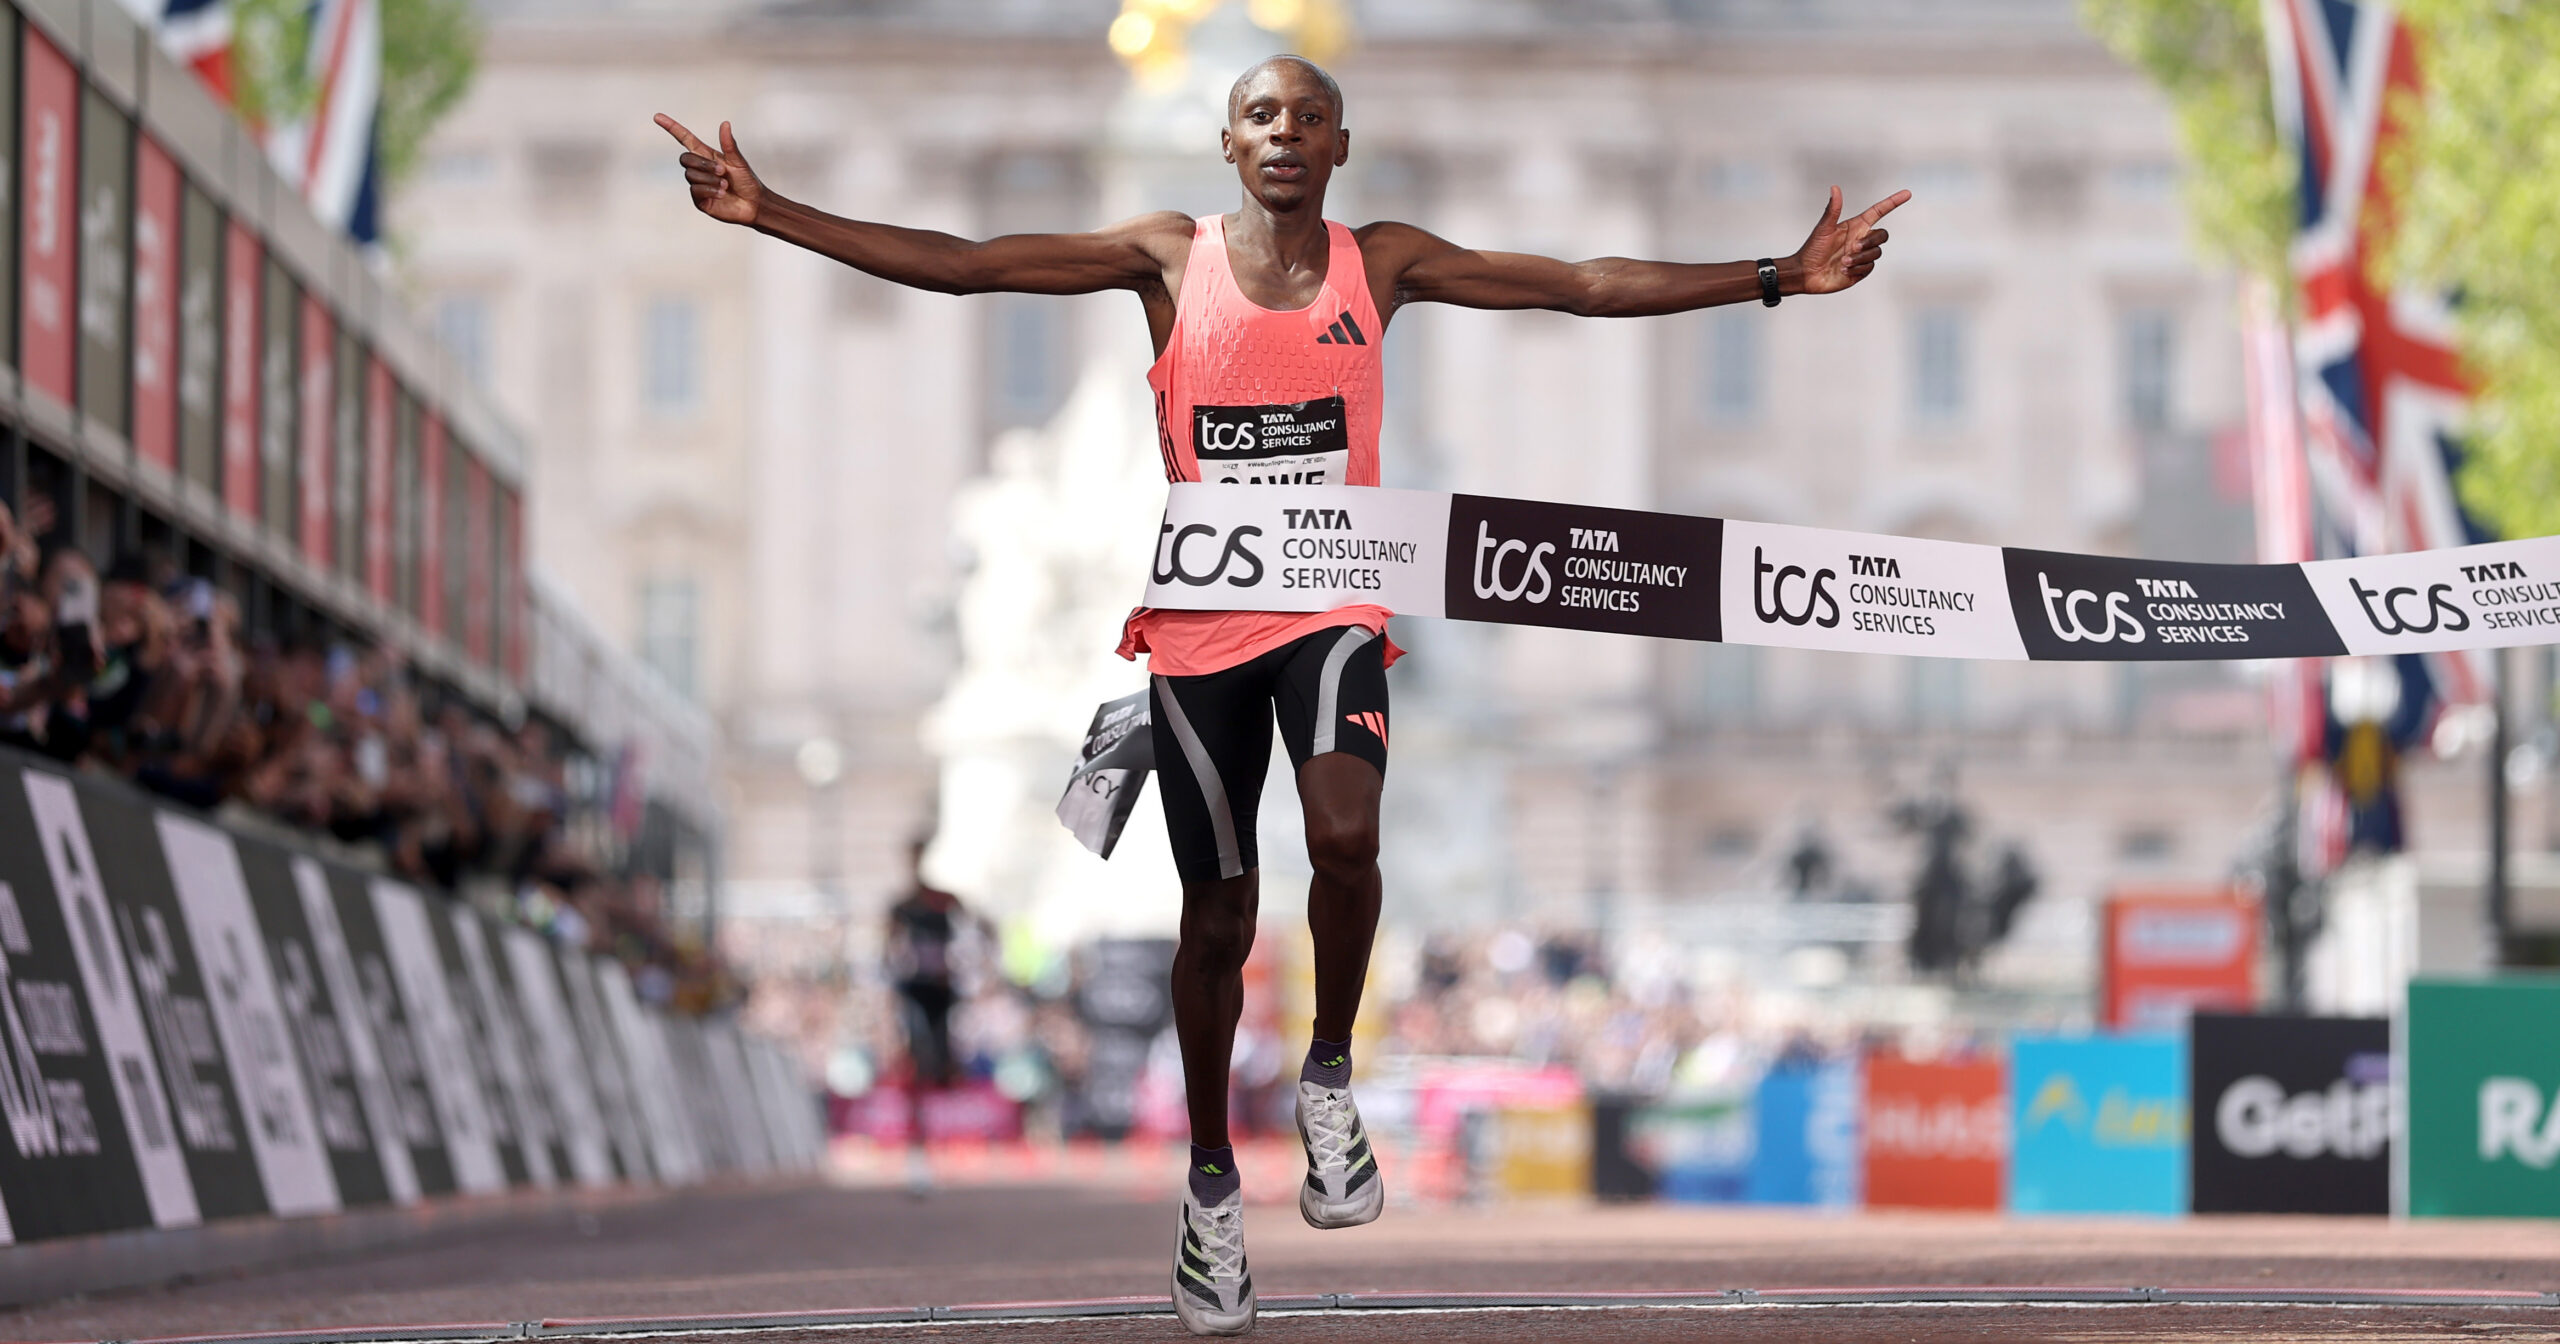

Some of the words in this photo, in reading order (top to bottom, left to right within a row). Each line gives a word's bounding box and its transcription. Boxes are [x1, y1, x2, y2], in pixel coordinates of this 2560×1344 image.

[1260, 413, 1295, 425] TATA
[1261, 419, 1337, 437] CONSULTANCY
[1202, 415, 1256, 450] tcs
[1262, 435, 1312, 449] SERVICES
[1283, 509, 1352, 530] TATA
[1153, 508, 1264, 587] tcs
[1282, 538, 1417, 563] CONSULTANCY
[1569, 527, 1619, 552] TATA
[1473, 520, 1556, 604] tcs
[1564, 556, 1687, 588] CONSULTANCY
[1848, 554, 1901, 579] TATA
[2460, 561, 2528, 583] TATA
[1282, 568, 1381, 590] SERVICES
[1754, 545, 1840, 629] tcs
[2135, 578, 2199, 598] TATA
[1560, 585, 1640, 613] SERVICES
[1850, 583, 1975, 612] CONSULTANCY
[2038, 571, 2146, 643] tcs
[2349, 577, 2470, 635] tcs
[1852, 611, 1936, 636] SERVICES
[2146, 603, 2286, 621] CONSULTANCY
[2156, 625, 2250, 643] SERVICES
